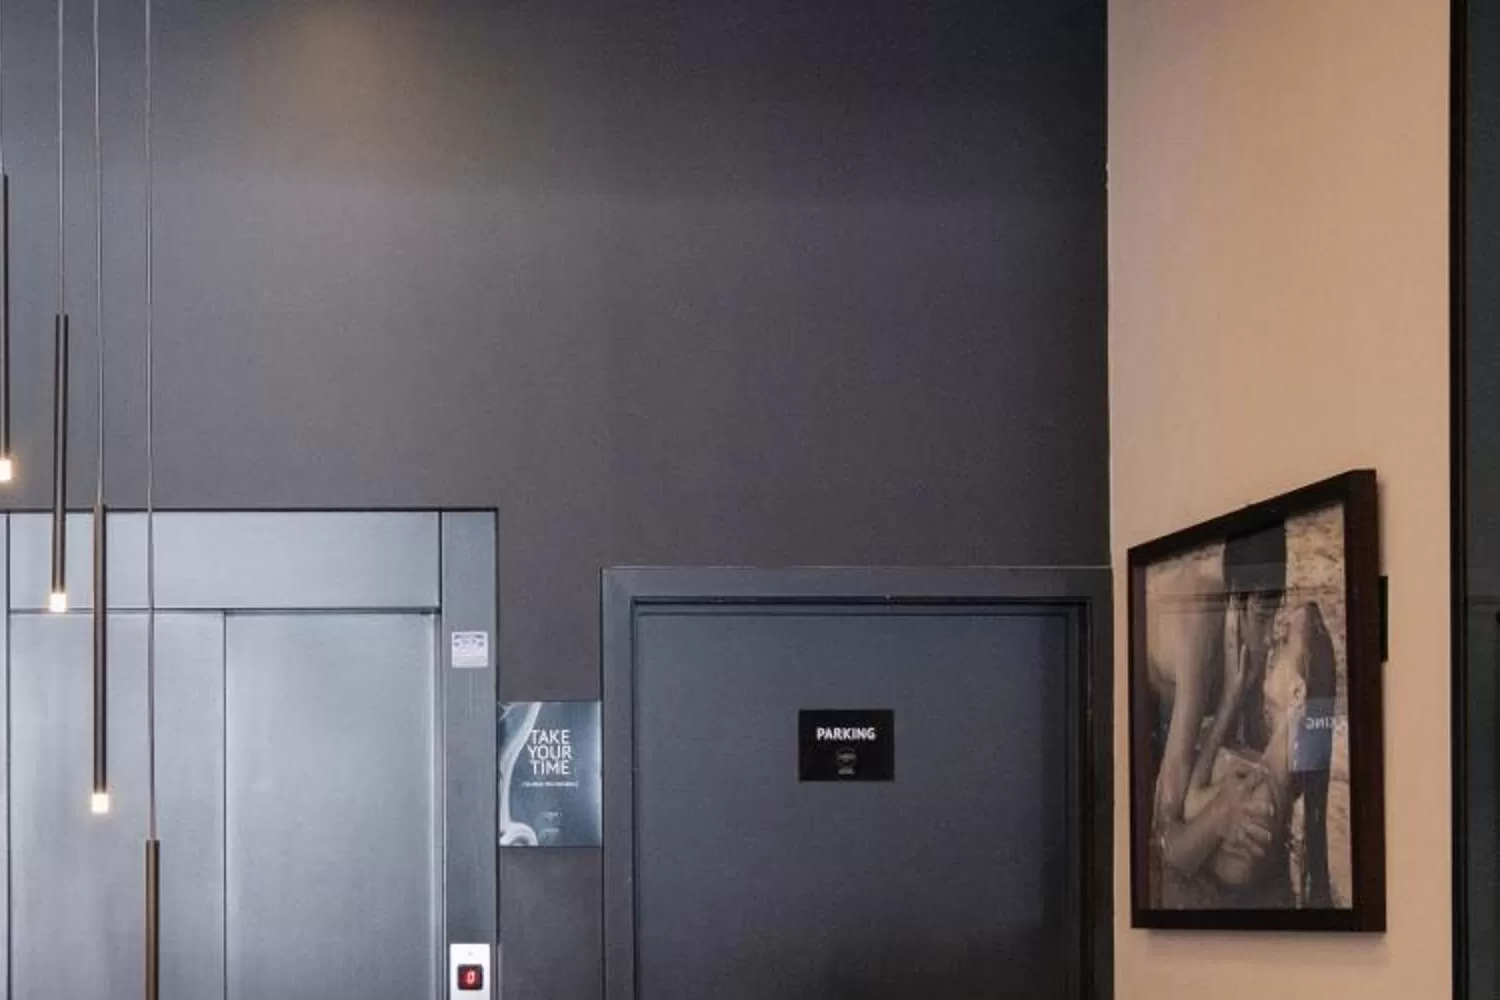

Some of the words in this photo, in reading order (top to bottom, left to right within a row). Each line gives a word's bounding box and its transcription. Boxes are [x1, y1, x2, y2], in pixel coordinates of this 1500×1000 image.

[532, 729, 572, 745] TAKE
[816, 727, 877, 741] PARKING
[527, 745, 573, 760] YOUR
[530, 760, 572, 776] TIME
